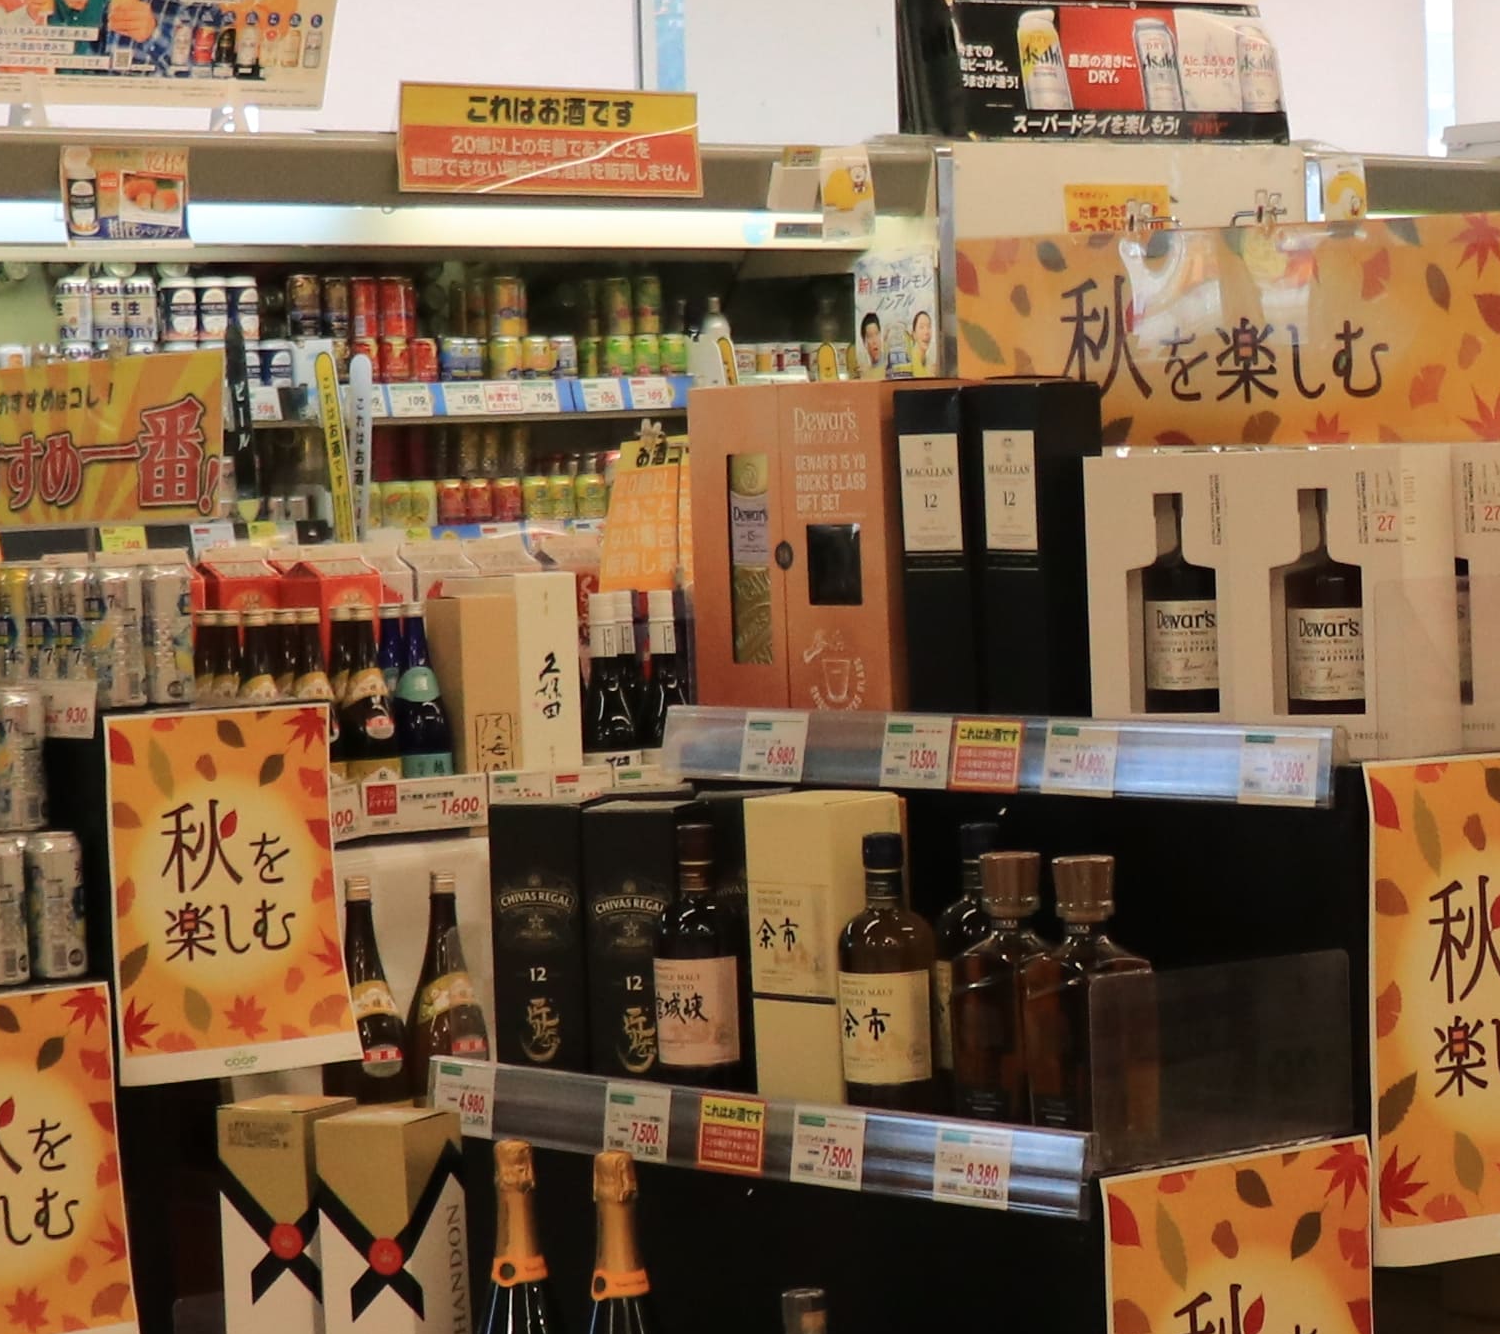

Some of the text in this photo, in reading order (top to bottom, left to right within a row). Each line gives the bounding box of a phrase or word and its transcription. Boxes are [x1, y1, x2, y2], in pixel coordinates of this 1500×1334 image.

[466, 95, 634, 128] これはお酒です
[451, 134, 651, 162] 20歳以上の年齢であることを
[411, 156, 690, 185] 確認できない場合には酒類を販売しません
[1060, 275, 1390, 404] 秋を楽しむ
[793, 407, 857, 432] Dewar's
[796, 473, 867, 492] ROCKS GLASS
[905, 466, 955, 479] MACALLAN
[796, 495, 841, 512] GIFT SET
[923, 494, 938, 508] 12
[161, 799, 290, 893] 秋を
[500, 891, 573, 909] CHIVAS REGAL
[165, 899, 296, 962] 楽しむ
[843, 1008, 892, 1041] 余市
